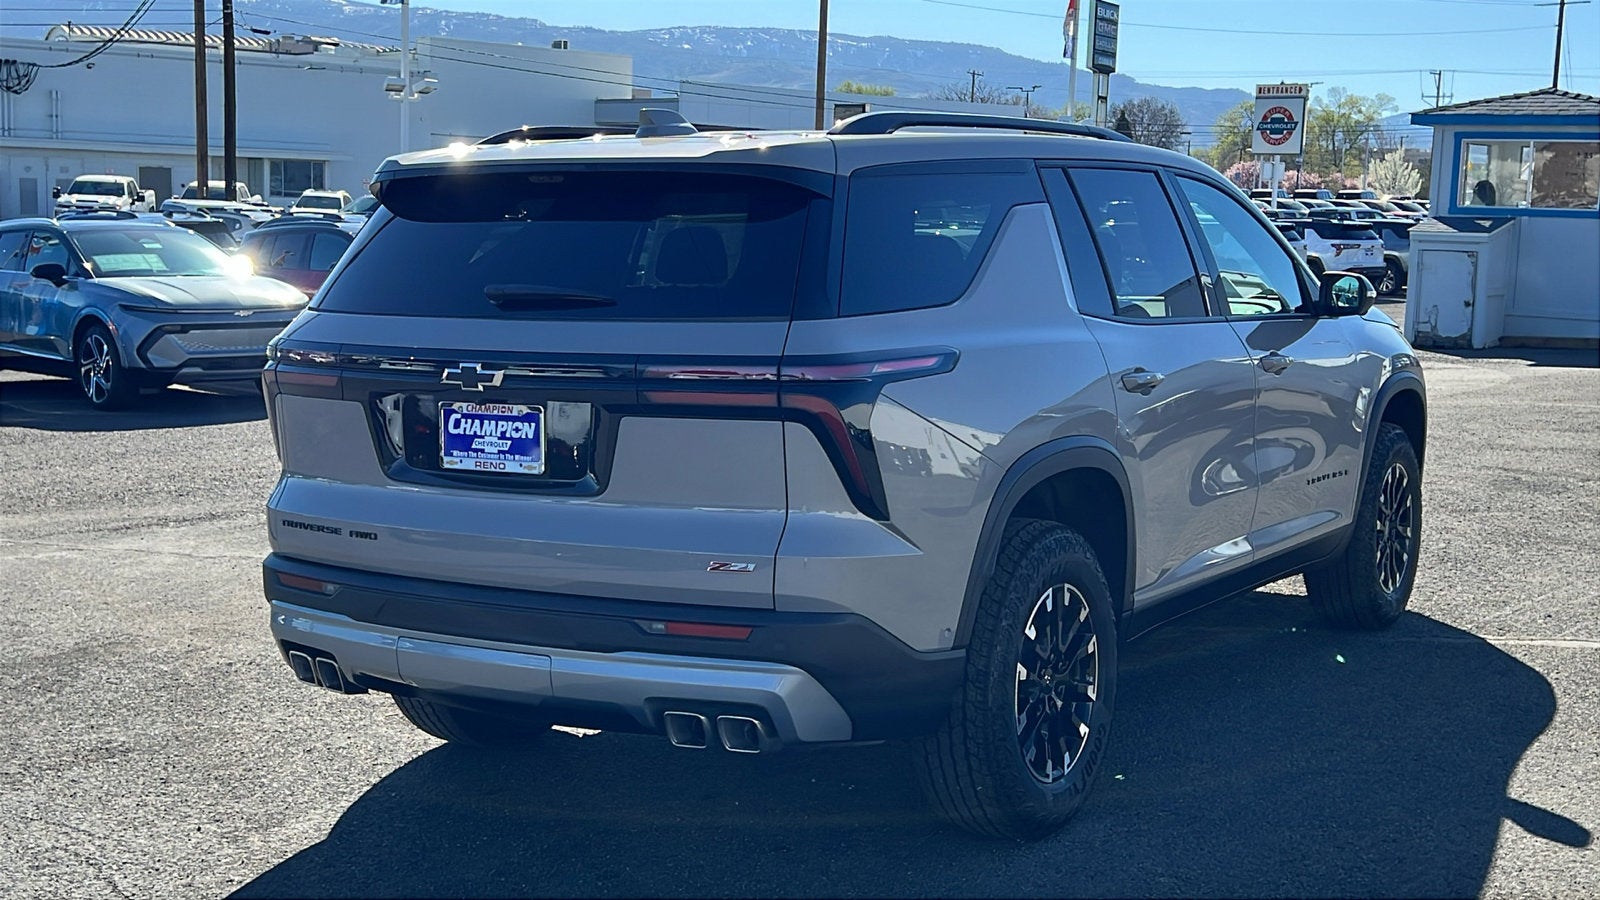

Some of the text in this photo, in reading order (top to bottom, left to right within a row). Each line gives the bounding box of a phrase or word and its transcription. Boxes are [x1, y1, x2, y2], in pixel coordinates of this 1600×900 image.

[1263, 86, 1298, 95] ENTRANCE
[466, 404, 514, 414] CHAMPION
[448, 413, 536, 438] CHAMPION
[474, 440, 509, 449] CHEVROLET
[474, 460, 506, 471] RENO
[282, 519, 378, 541] TRAVERSE AWD
[706, 560, 757, 573] Z71
